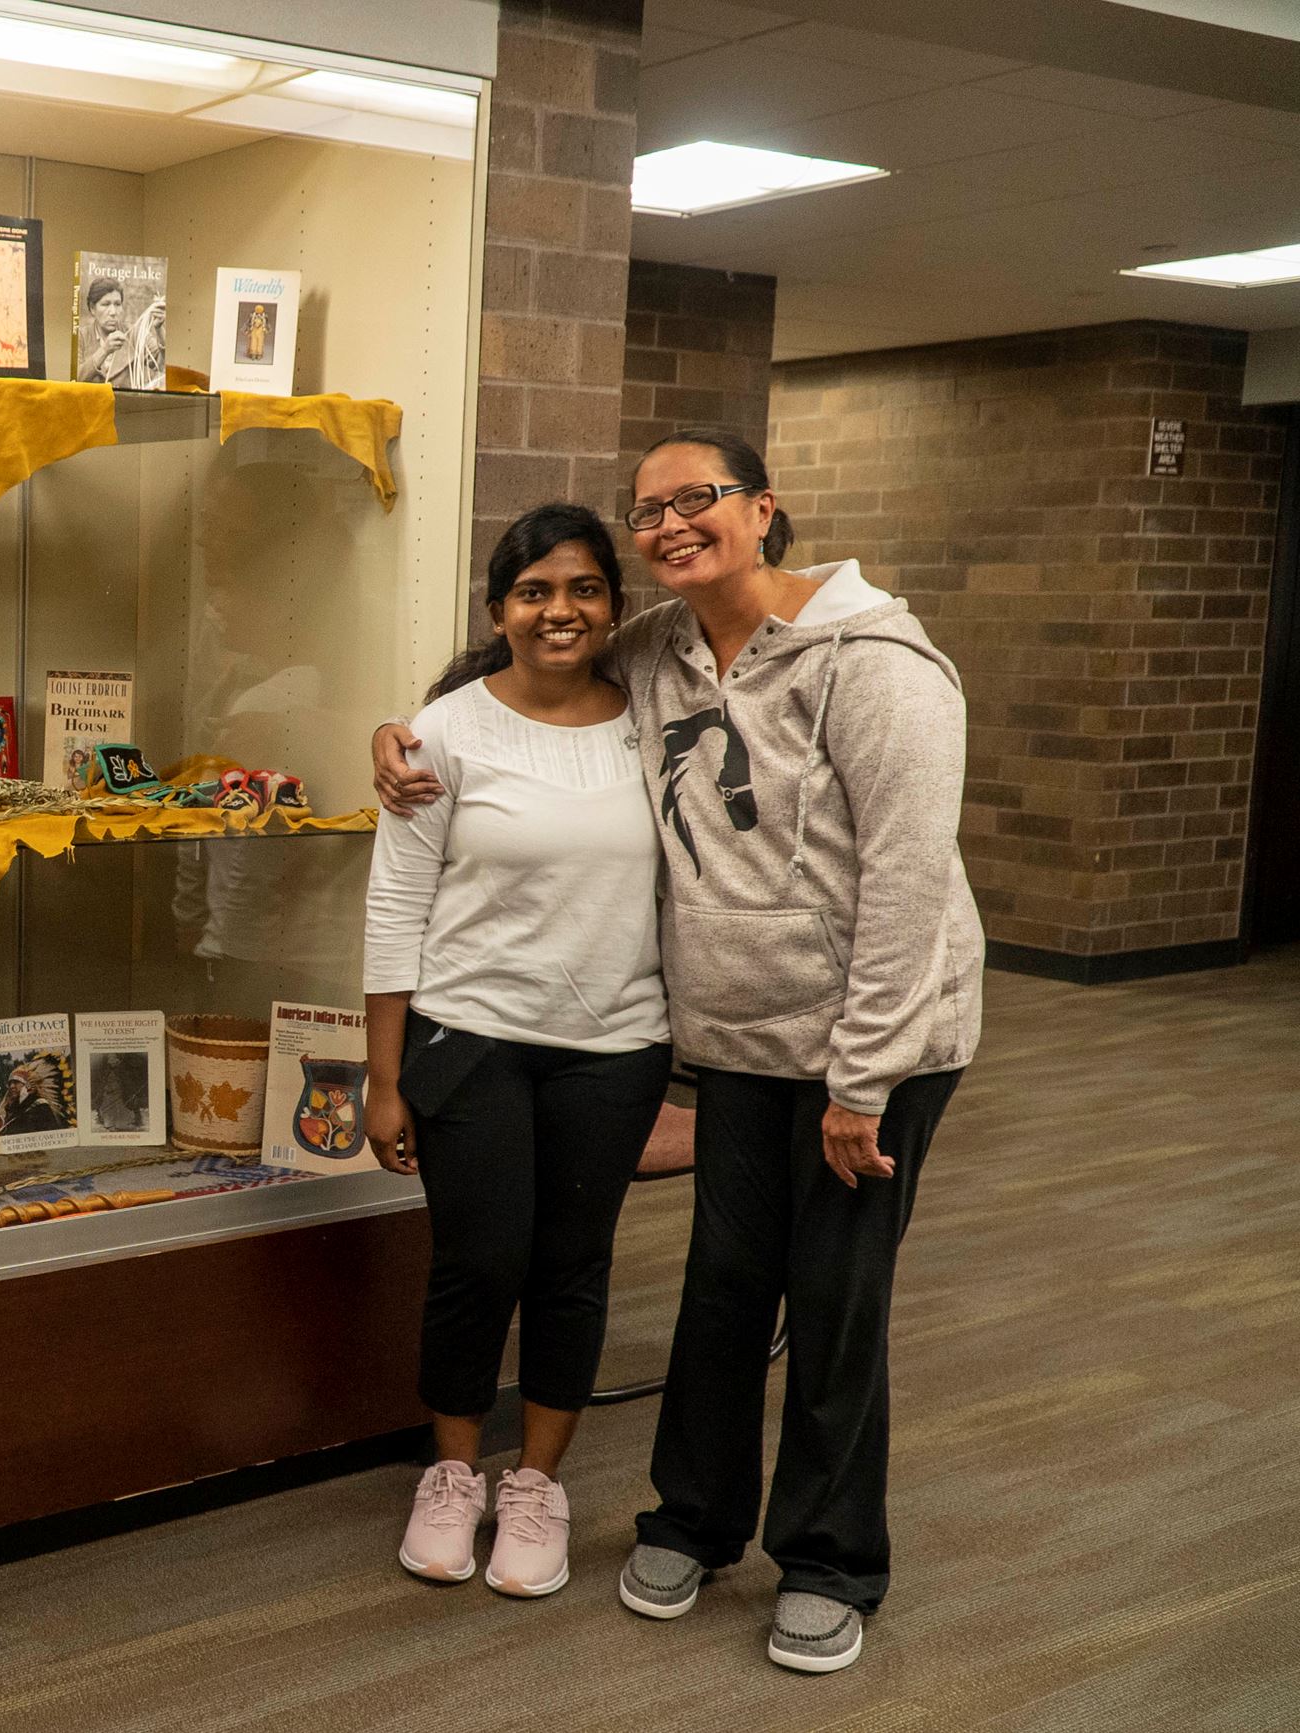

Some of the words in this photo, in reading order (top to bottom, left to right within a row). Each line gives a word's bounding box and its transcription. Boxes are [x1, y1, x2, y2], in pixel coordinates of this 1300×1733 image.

[88, 262, 132, 282] Portage
[133, 266, 162, 280] Lake
[234, 278, 285, 300] Waterlily
[1158, 420, 1182, 432] SEVERE
[1154, 432, 1185, 443] WEATHER
[1154, 442, 1183, 454] SHELTER
[1158, 454, 1177, 465] AREA
[51, 680, 82, 696] LOUISE
[86, 682, 127, 697] ERDRICH
[50, 702, 126, 719] BIRCHBARK
[65, 718, 108, 732] HOUSE
[80, 1020, 93, 1028] WE
[134, 1019, 158, 1027] RIGHT
[276, 1006, 312, 1022] American
[313, 1010, 336, 1025] Indian
[338, 1012, 354, 1027] Past
[354, 1015, 361, 1028] &
[12, 1020, 25, 1034] of
[26, 1018, 66, 1032] Power
